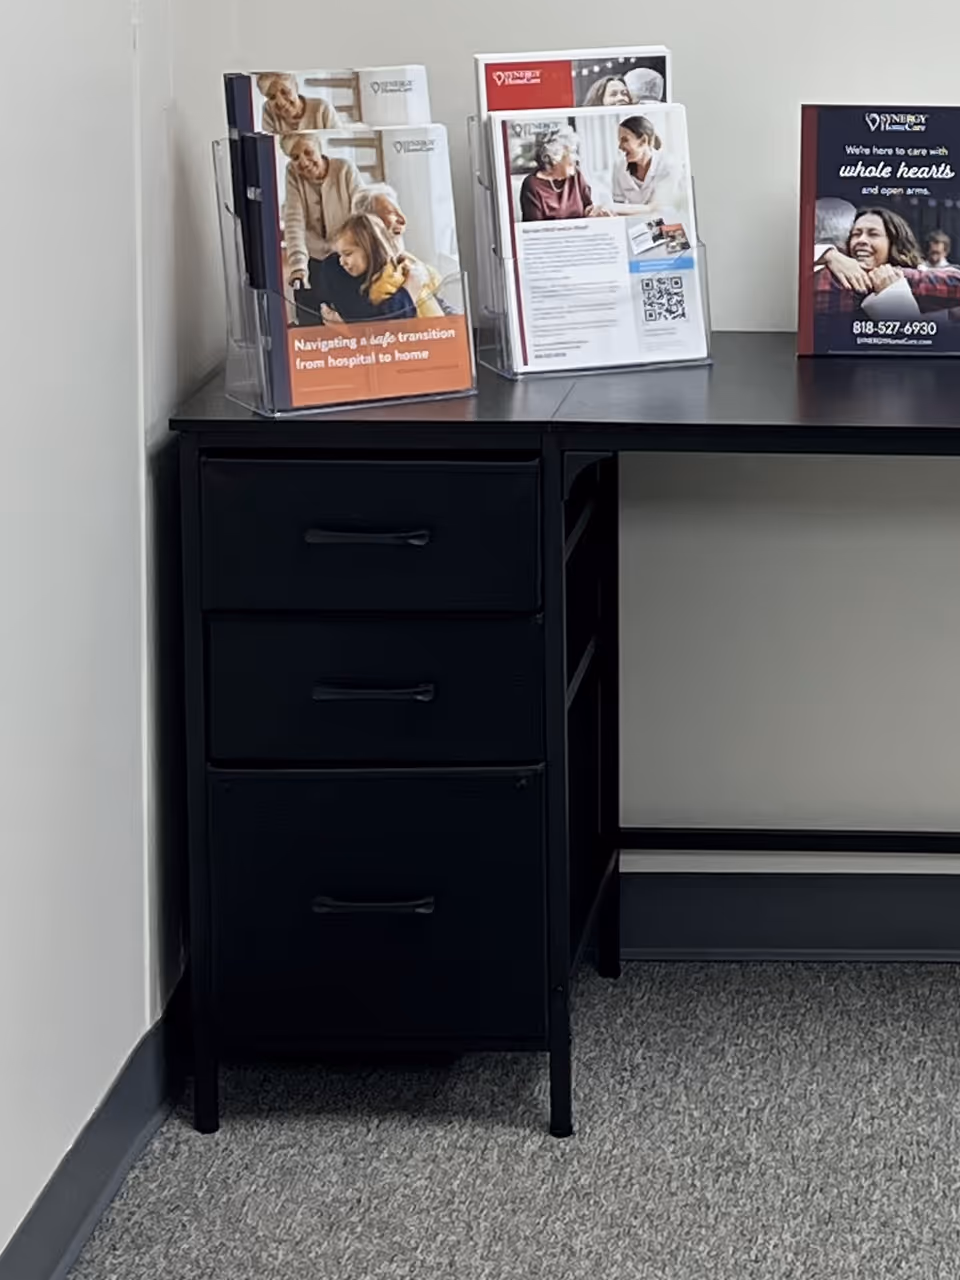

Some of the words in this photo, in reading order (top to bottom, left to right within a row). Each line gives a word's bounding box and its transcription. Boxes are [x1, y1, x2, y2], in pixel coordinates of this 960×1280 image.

[872, 145, 894, 155] here
[895, 147, 905, 155] to
[907, 147, 928, 156] care
[929, 146, 949, 156] with
[839, 160, 893, 179] whole
[896, 161, 956, 179] hearts
[861, 185, 879, 195] and
[880, 187, 904, 196] open
[852, 320, 937, 336] 818-527-6930
[294, 335, 357, 353] Navigating
[360, 338, 367, 346] a
[370, 331, 397, 348] safe
[398, 327, 455, 342] transition
[295, 357, 326, 370] from
[328, 352, 376, 369] hospital
[378, 352, 392, 363] to
[394, 349, 429, 363] home
